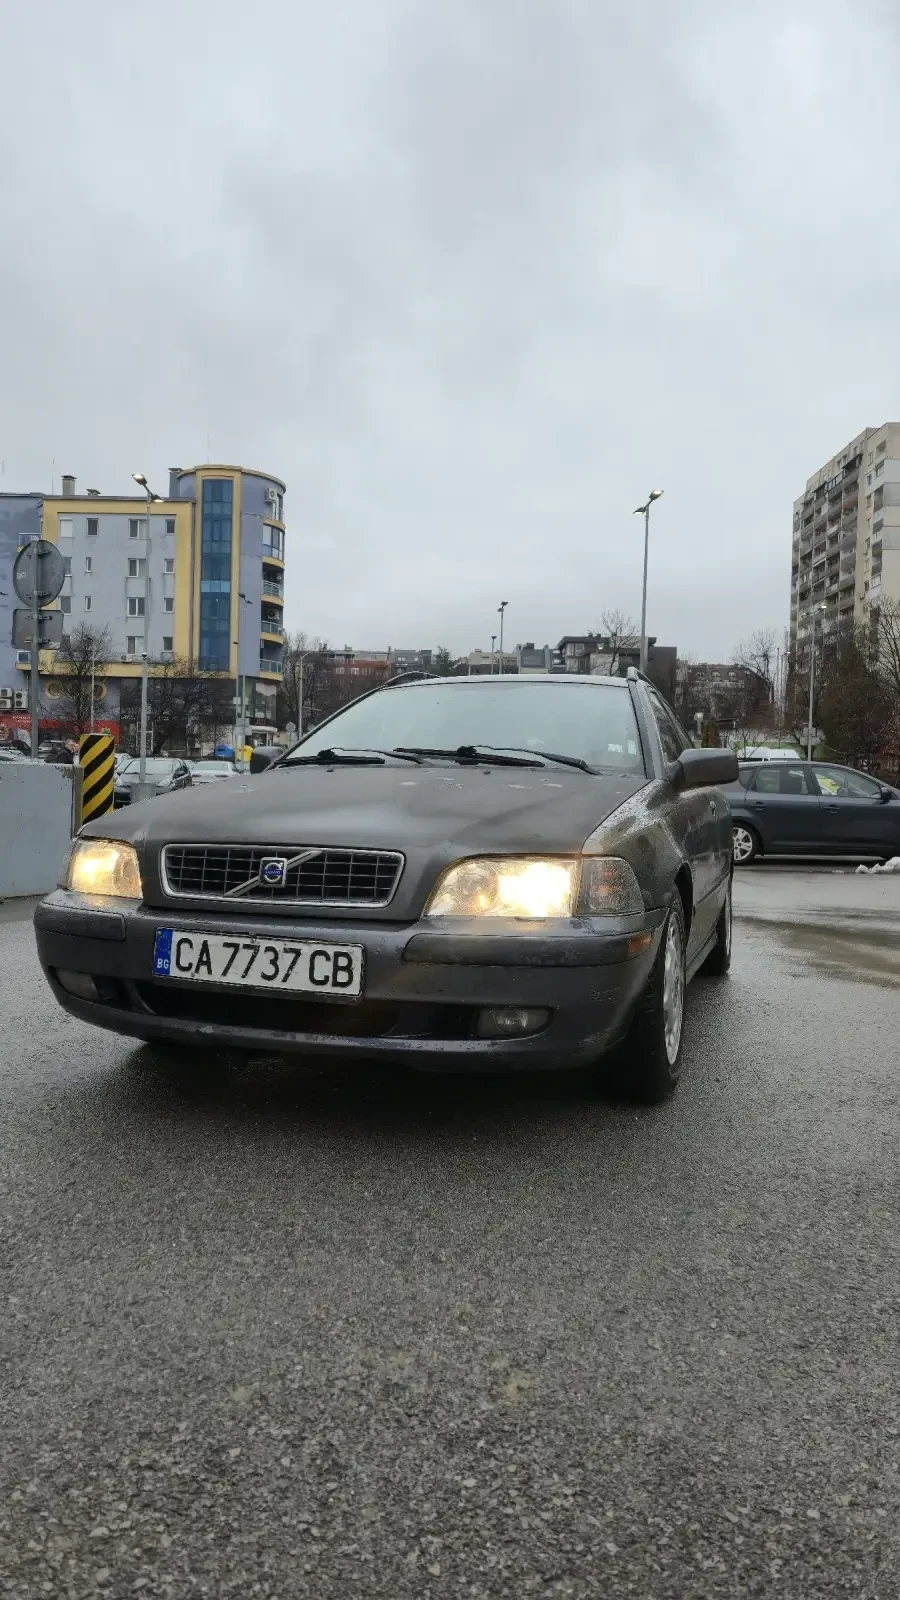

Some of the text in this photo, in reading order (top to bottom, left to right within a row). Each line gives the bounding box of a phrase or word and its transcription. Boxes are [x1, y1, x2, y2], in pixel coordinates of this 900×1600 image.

[157, 958, 170, 969] BG
[175, 937, 354, 988] CA 7737 CB
